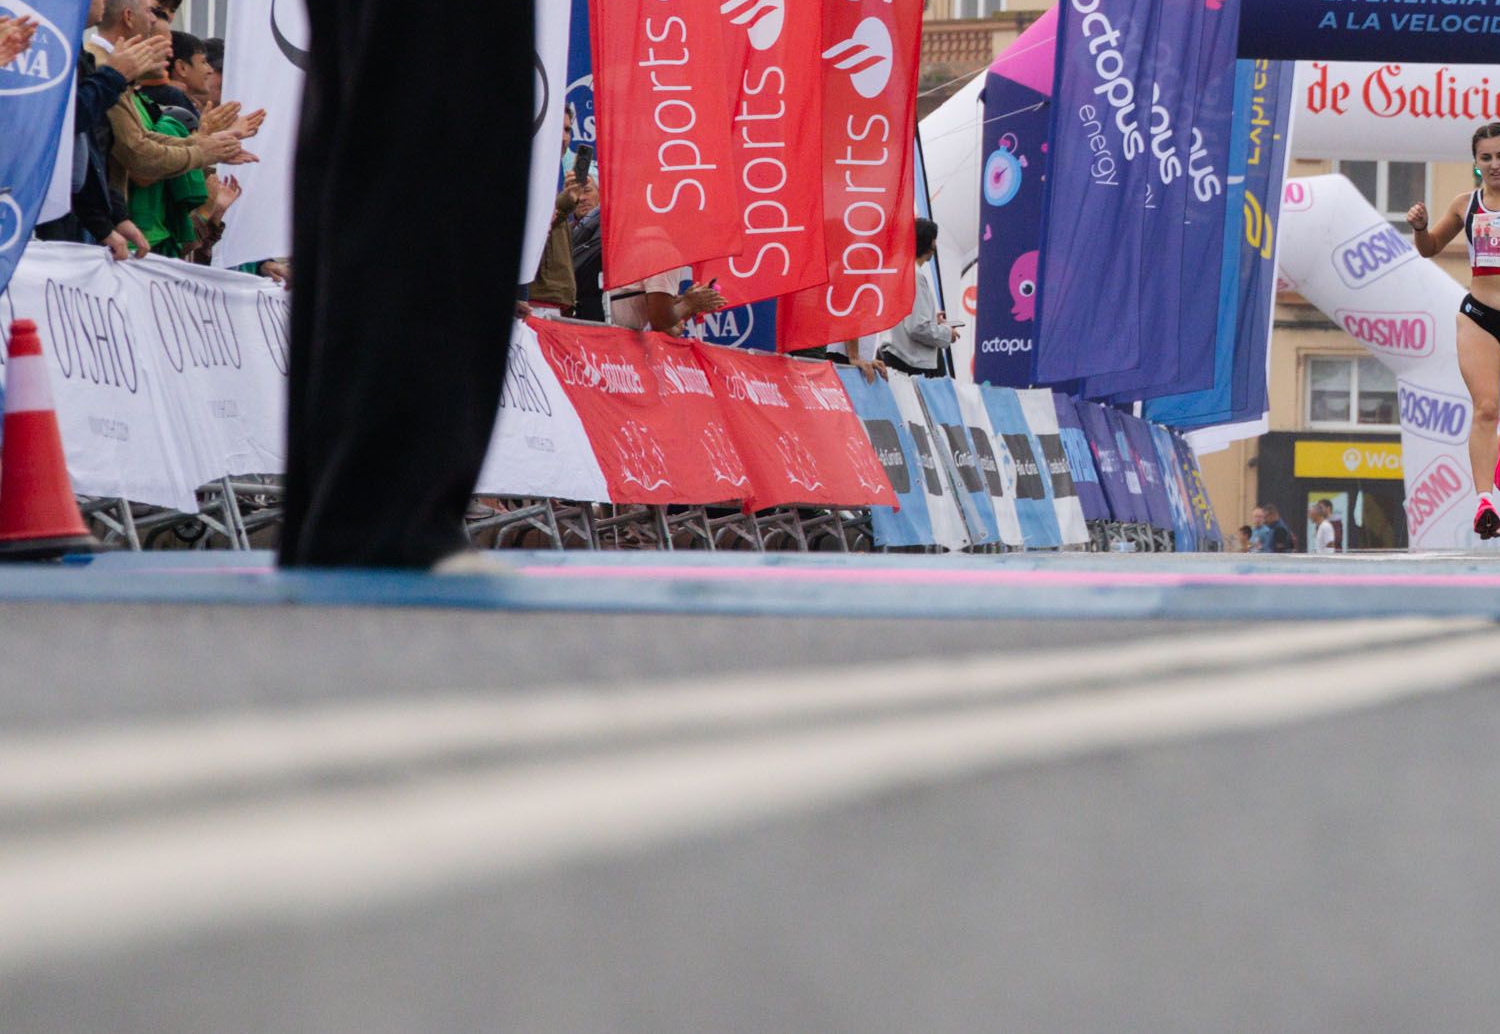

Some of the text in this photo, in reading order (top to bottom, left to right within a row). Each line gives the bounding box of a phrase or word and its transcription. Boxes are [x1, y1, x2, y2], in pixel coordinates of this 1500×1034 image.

[1318, 11, 1338, 30] A
[1346, 13, 1380, 32] LA
[639, 16, 718, 214] Sports
[1307, 62, 1350, 115] de
[728, 66, 804, 279] Sports
[1079, 104, 1119, 186] energy
[827, 113, 898, 318] Sports
[1344, 315, 1427, 351] COSMO
